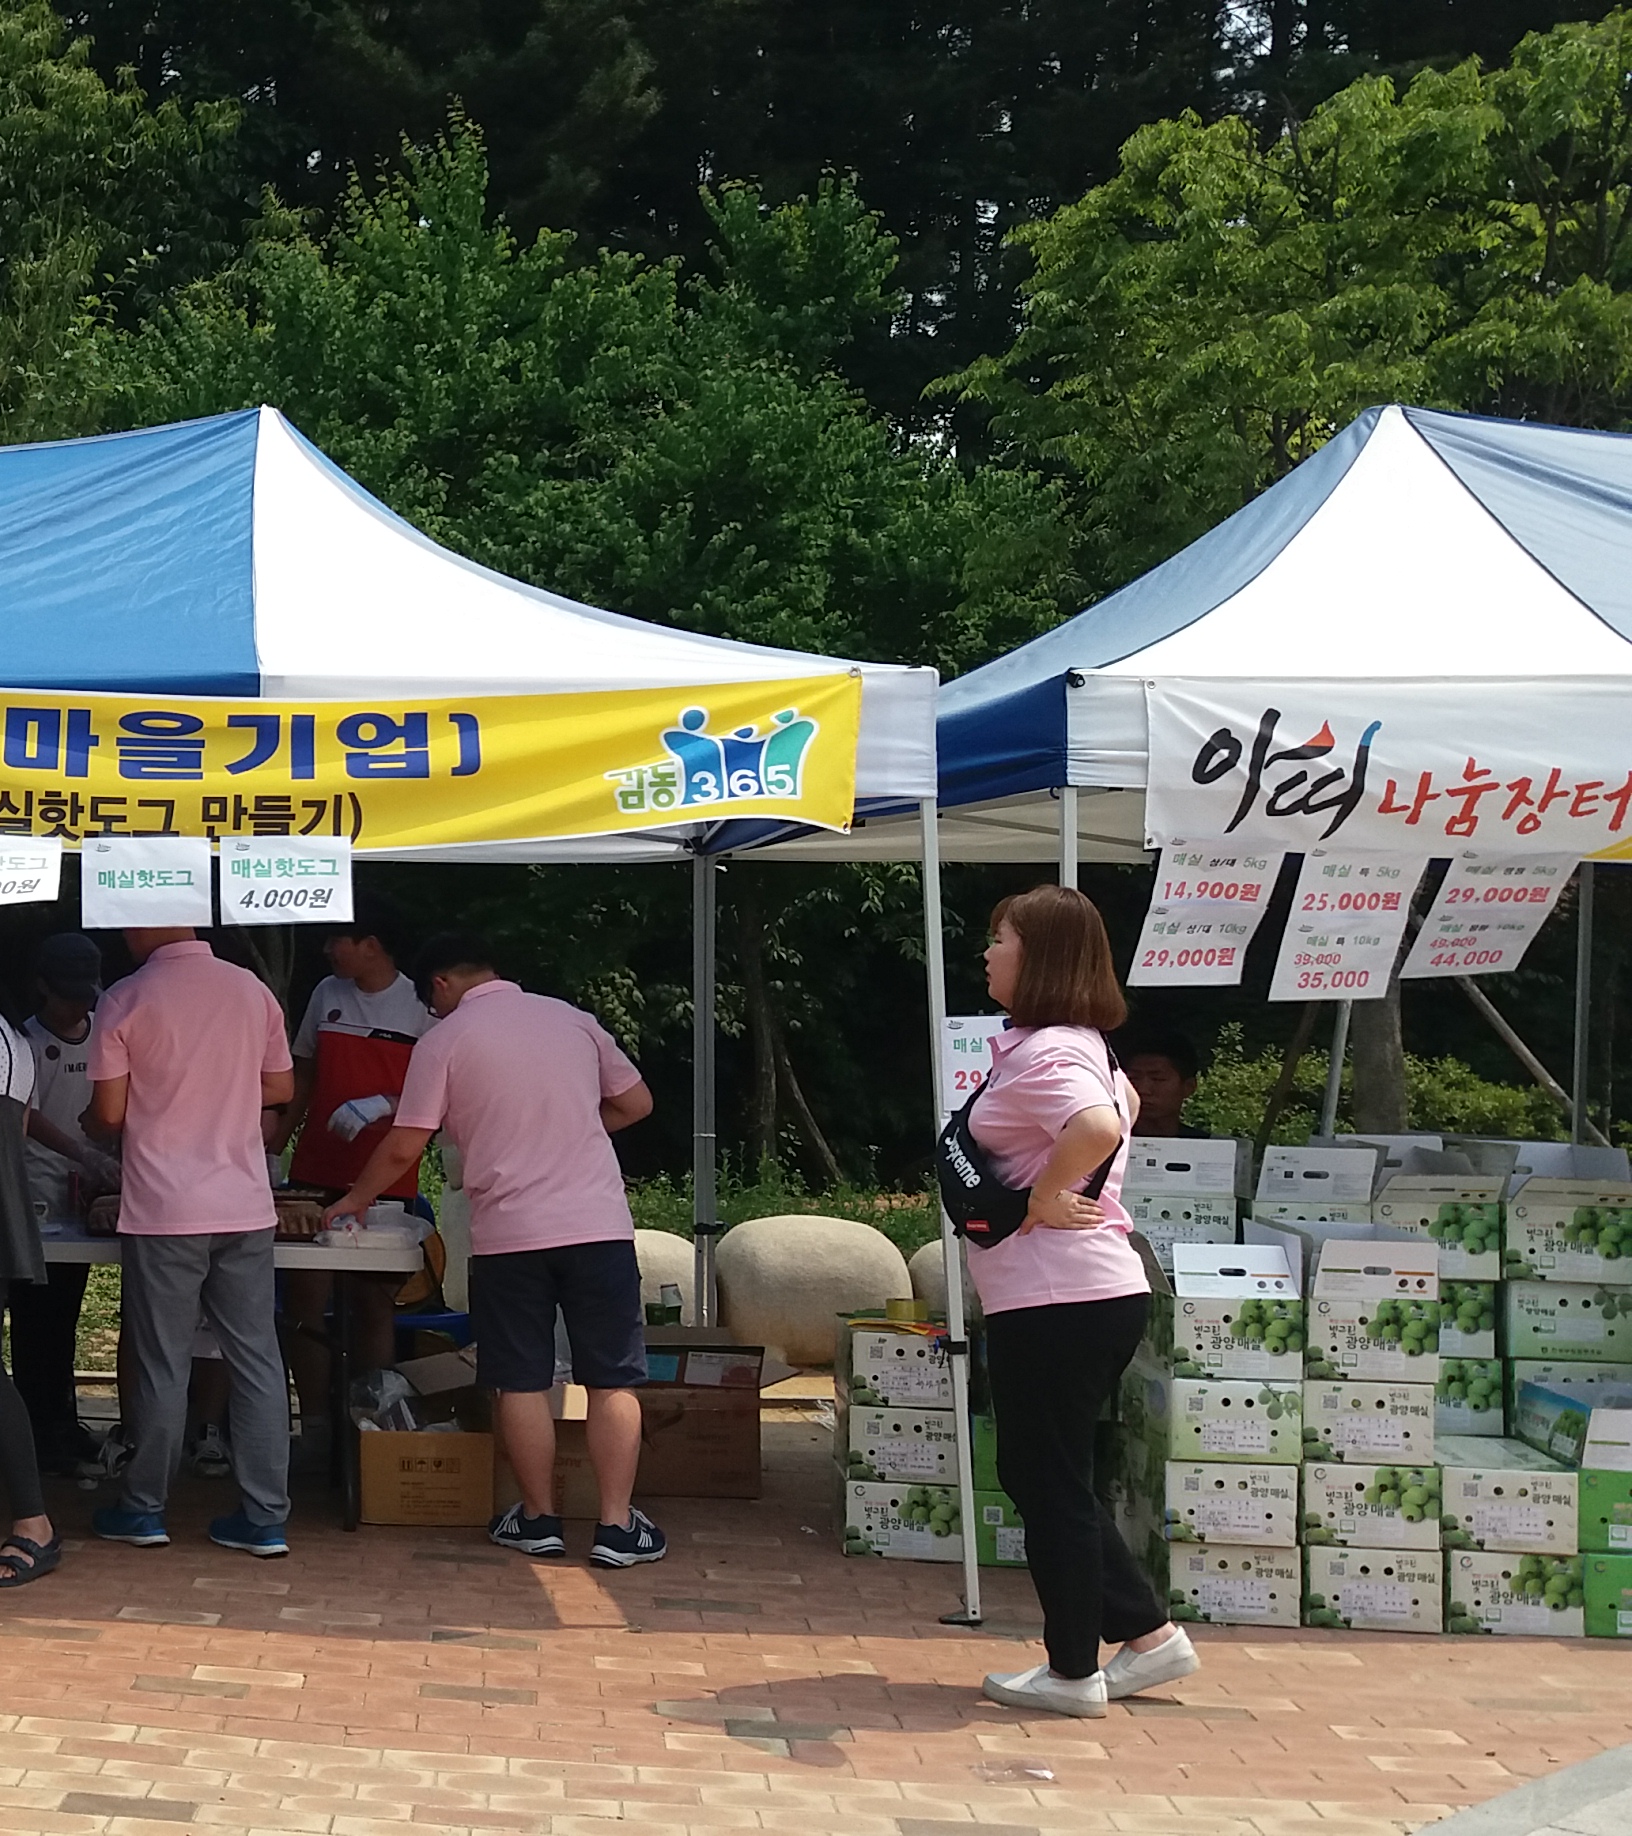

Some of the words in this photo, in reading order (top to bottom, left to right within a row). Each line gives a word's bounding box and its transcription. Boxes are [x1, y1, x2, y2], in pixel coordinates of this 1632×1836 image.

[604, 760, 679, 811] 감동
[690, 763, 796, 803] 365
[1377, 756, 1632, 838] 나눔장터
[200, 791, 363, 844] 만들기)
[228, 855, 341, 880] 매실핫도그
[1172, 852, 1203, 867] 매실
[1243, 857, 1267, 871] 5kg
[96, 866, 196, 891] 매실핫도그
[1322, 864, 1352, 878] 매실
[1376, 866, 1401, 879] 5kg
[239, 885, 334, 911] 4.000원
[1164, 880, 1262, 903] 14,900원
[1444, 886, 1552, 904] 29,000원
[1301, 892, 1402, 912] 25,000원
[1152, 921, 1181, 936] 매실
[1218, 923, 1247, 936] 10kg
[1306, 936, 1329, 948] 매실
[1353, 935, 1380, 947] 10kg
[1141, 947, 1237, 968] 29,000원
[1429, 949, 1504, 967] 44,000
[1297, 970, 1369, 990] 35,000
[953, 1037, 983, 1053] 매실
[944, 1126, 981, 1189] Supreme
[1194, 1214, 1212, 1225] 광양
[1212, 1215, 1229, 1226] 매실
[1543, 1239, 1568, 1252] 광양
[1210, 1336, 1235, 1350] 광양
[1237, 1336, 1262, 1351] 매실
[1345, 1336, 1371, 1350] 광양
[1373, 1336, 1397, 1351] 매실
[1389, 1404, 1409, 1416] 광양
[1409, 1405, 1429, 1417] 매실
[925, 1431, 942, 1442] 광양
[1250, 1487, 1269, 1499] 광양
[1270, 1488, 1289, 1500] 매실
[1342, 1502, 1369, 1516] 광양
[1371, 1503, 1396, 1517] 매실
[879, 1517, 902, 1530] 광양
[903, 1519, 925, 1532] 매실
[1255, 1567, 1274, 1579] 광양
[1275, 1568, 1295, 1580] 매실
[1489, 1591, 1515, 1605] 광양
[1517, 1593, 1542, 1606] 매실
